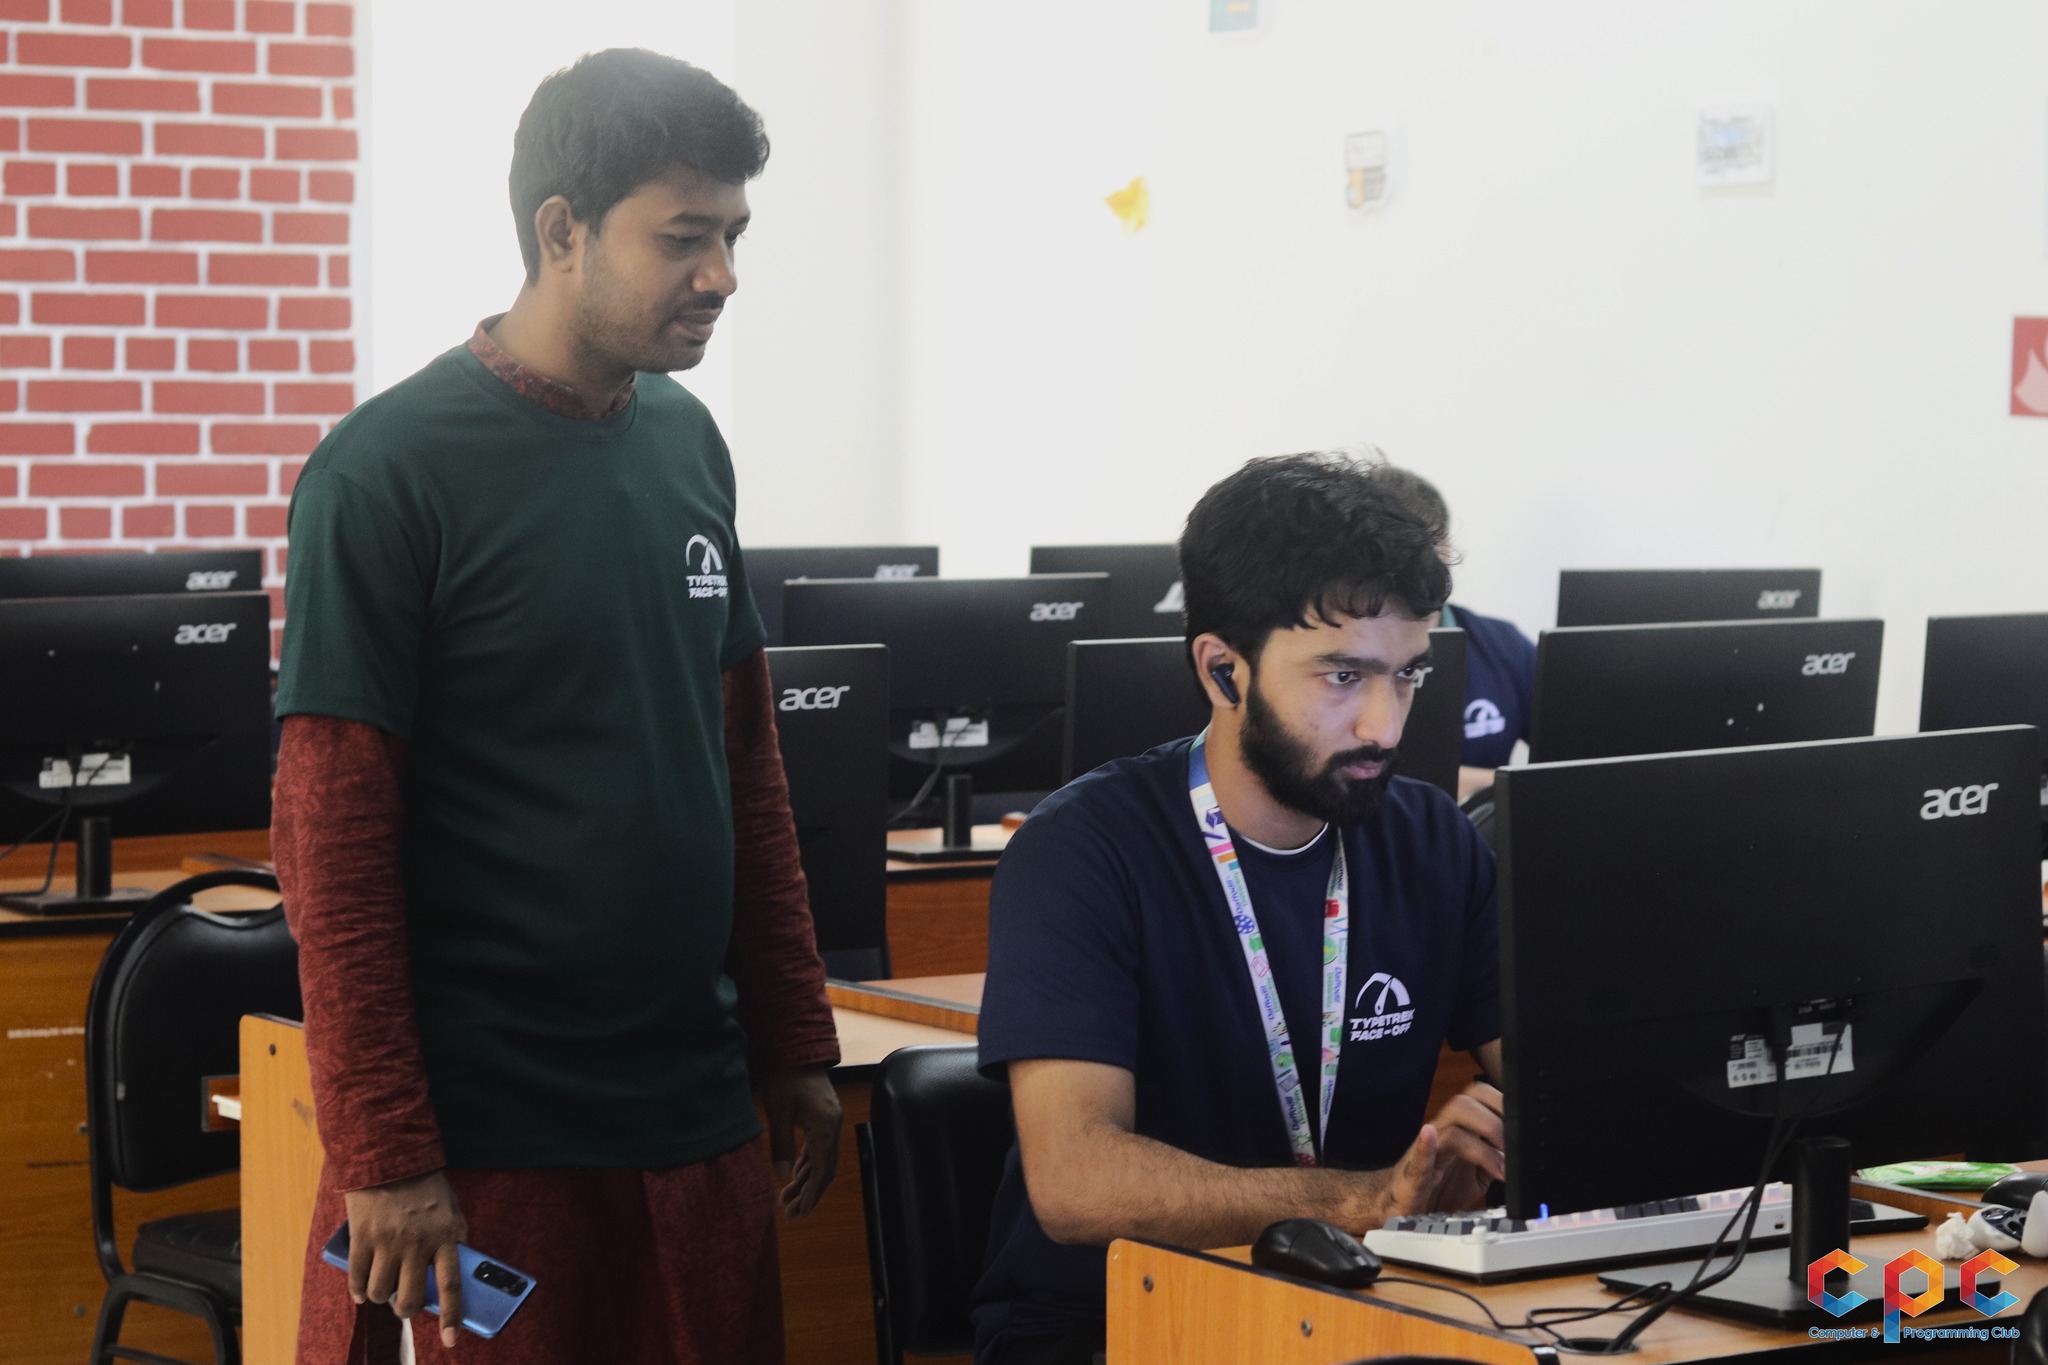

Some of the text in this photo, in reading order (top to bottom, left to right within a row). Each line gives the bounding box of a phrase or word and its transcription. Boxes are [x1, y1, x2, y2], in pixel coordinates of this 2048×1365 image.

[186, 571, 237, 590] acer
[1757, 590, 1800, 609] acer
[1029, 601, 1084, 621] acer
[174, 622, 237, 645] acer
[1801, 652, 1856, 676] acer
[778, 685, 851, 711] acer
[1919, 782, 1999, 821] acer
[1349, 1009, 1416, 1030] TYPETREK
